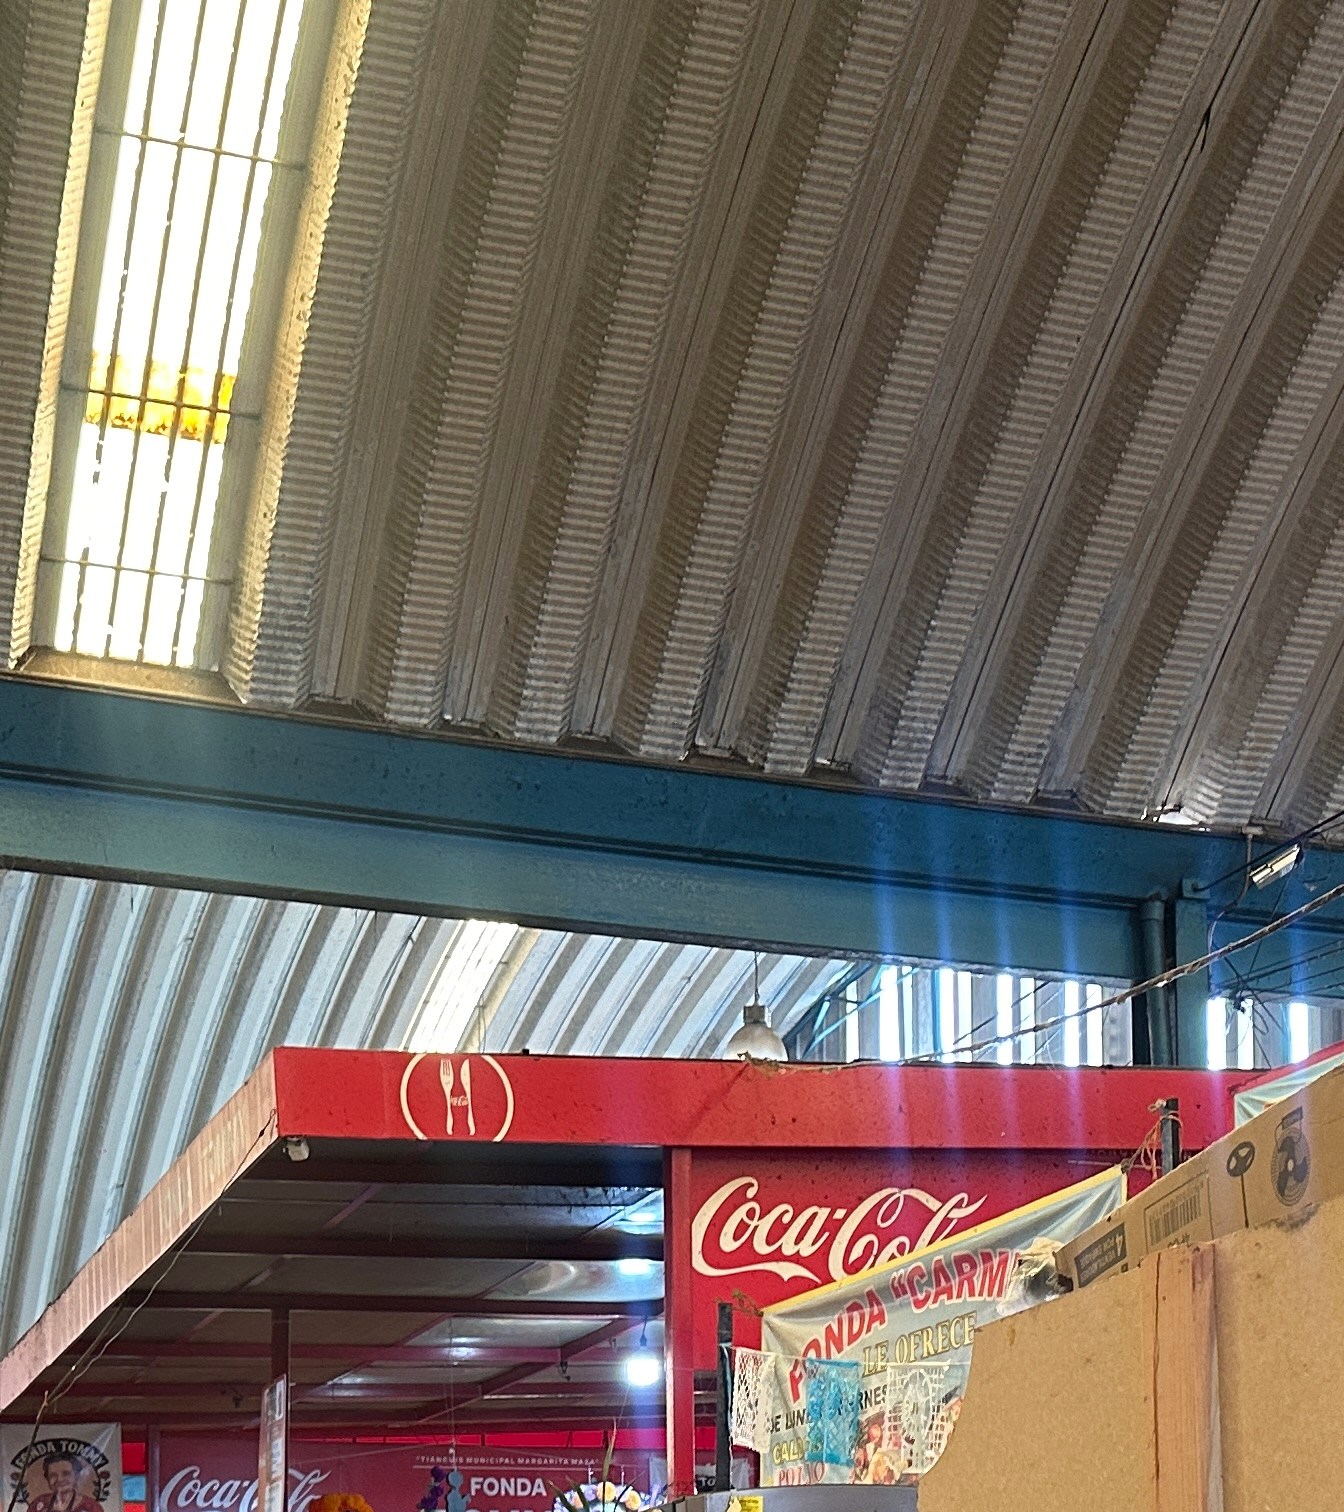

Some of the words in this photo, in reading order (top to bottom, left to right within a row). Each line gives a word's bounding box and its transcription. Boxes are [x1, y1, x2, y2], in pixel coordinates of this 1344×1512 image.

[691, 1176, 987, 1284] Coca-Col
[890, 1249, 1022, 1312] “CARM
[863, 1340, 888, 1378] LE
[895, 1311, 978, 1366] OFRECE
[470, 1477, 547, 1498] FONDA
